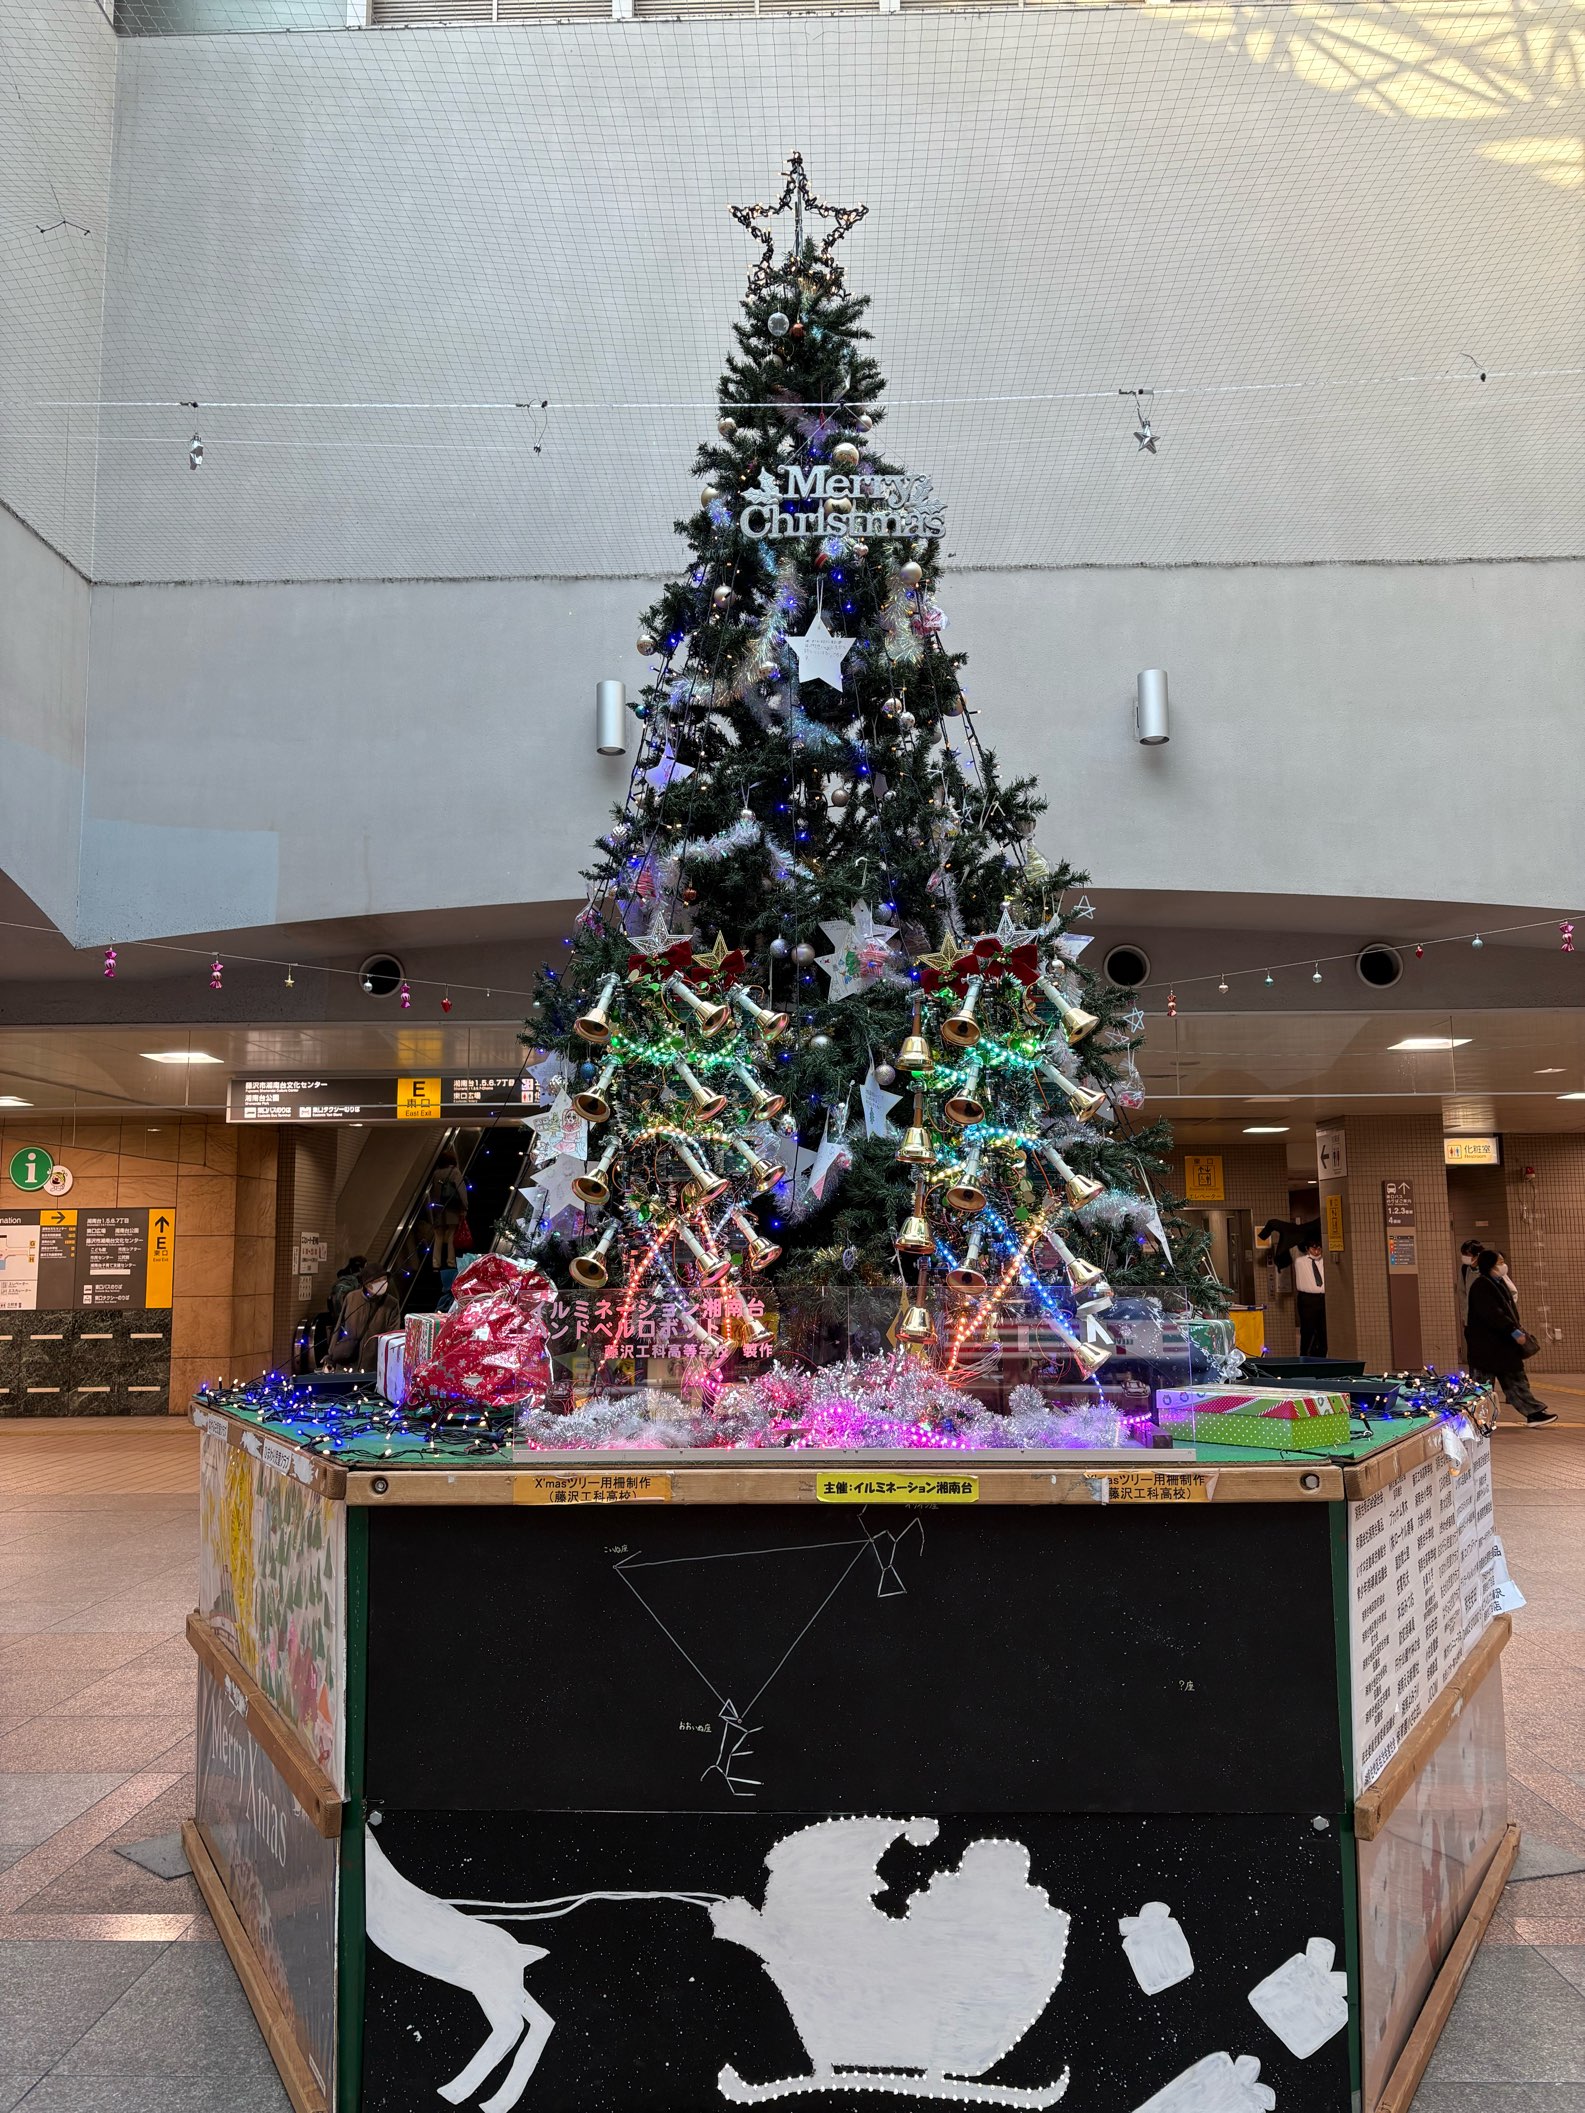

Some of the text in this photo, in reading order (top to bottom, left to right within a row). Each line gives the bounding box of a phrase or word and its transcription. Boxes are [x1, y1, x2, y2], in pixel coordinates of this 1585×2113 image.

[780, 465, 914, 509] Merry
[740, 504, 946, 539] Christmas
[413, 1081, 425, 1097] E
[406, 1098, 430, 1108] 東口
[1464, 1145, 1491, 1153] 化粧室
[157, 1237, 166, 1249] E
[604, 1343, 773, 1359] 藤沢工科高等学校 製作
[212, 1699, 245, 1802] Merry
[246, 1731, 287, 1868] Xmas
